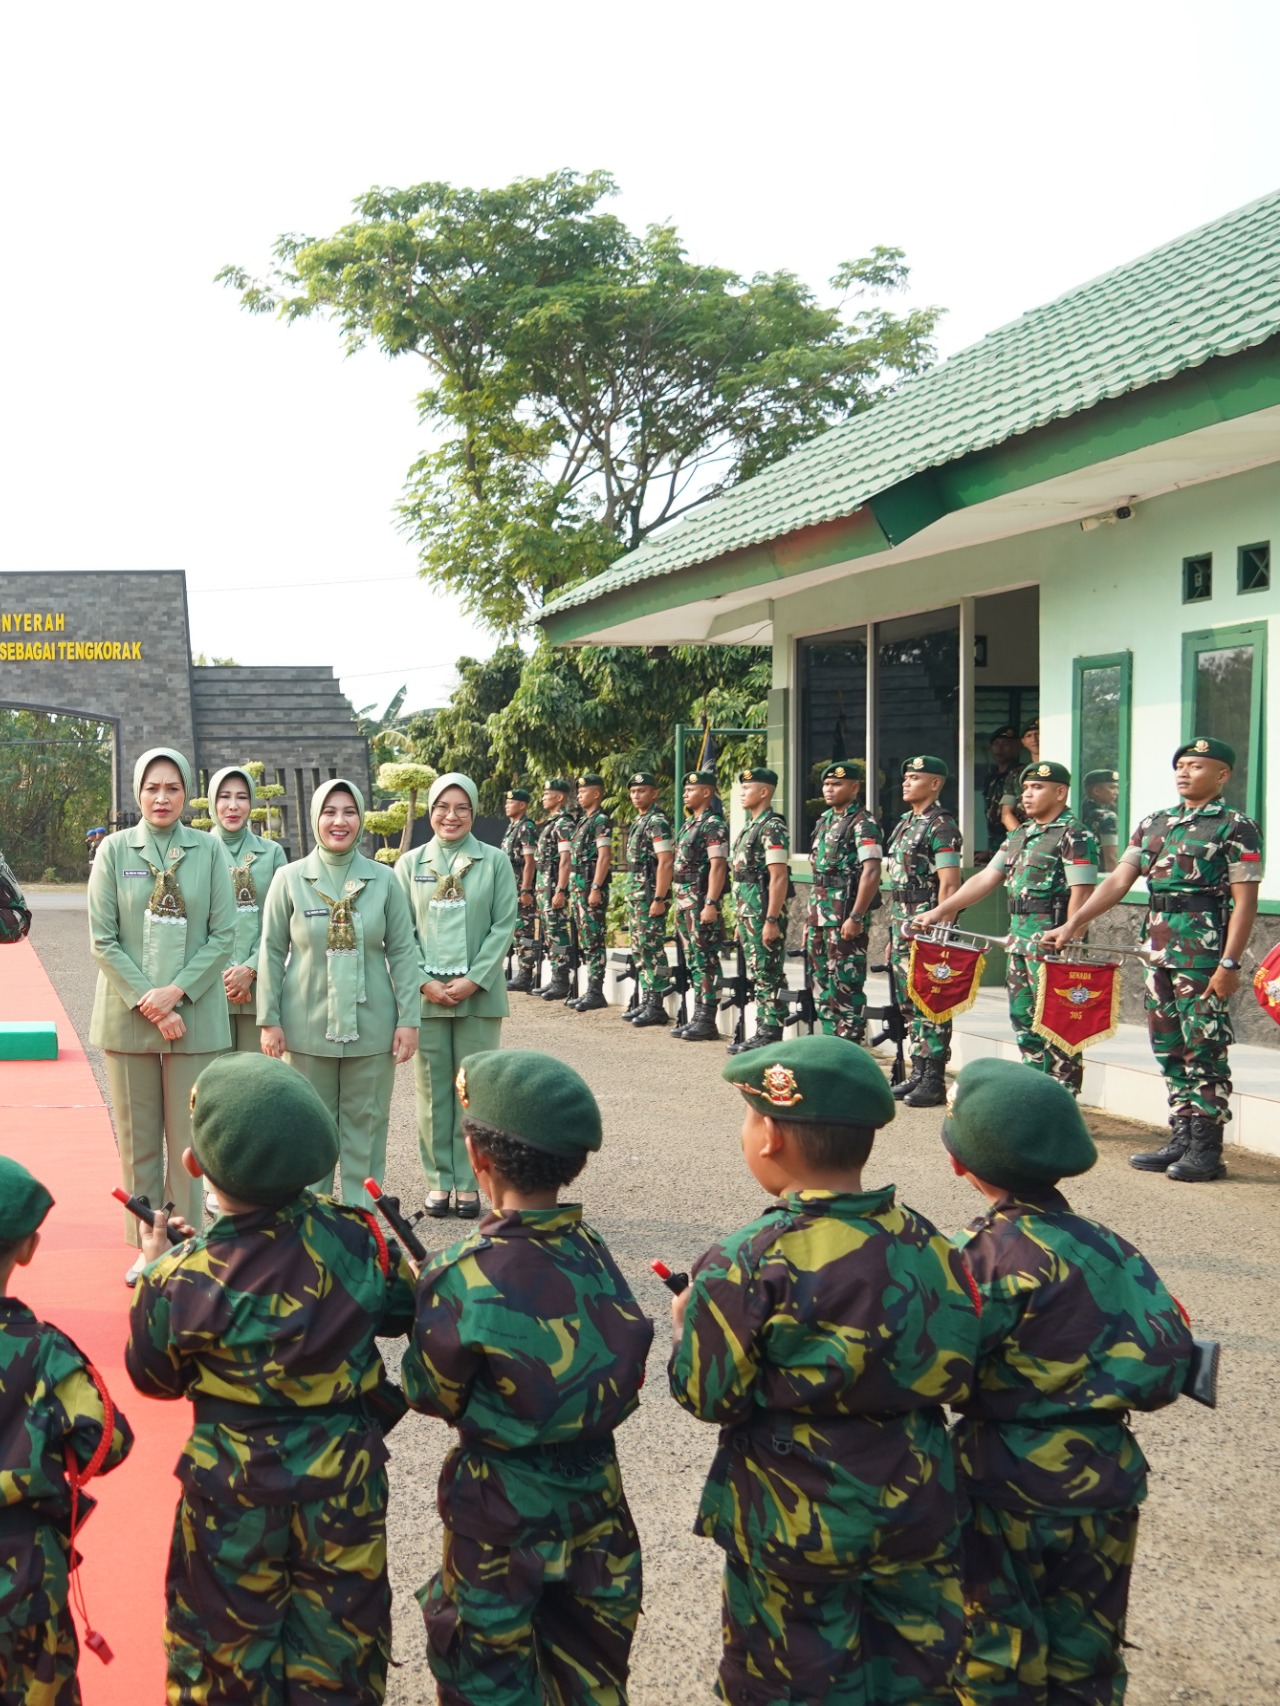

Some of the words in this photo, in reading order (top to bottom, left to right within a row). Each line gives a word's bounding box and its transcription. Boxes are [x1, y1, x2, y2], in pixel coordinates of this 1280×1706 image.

[57, 641, 142, 660] TENGKORAK
[939, 950, 950, 959] 41
[1069, 1011, 1083, 1020] 305
